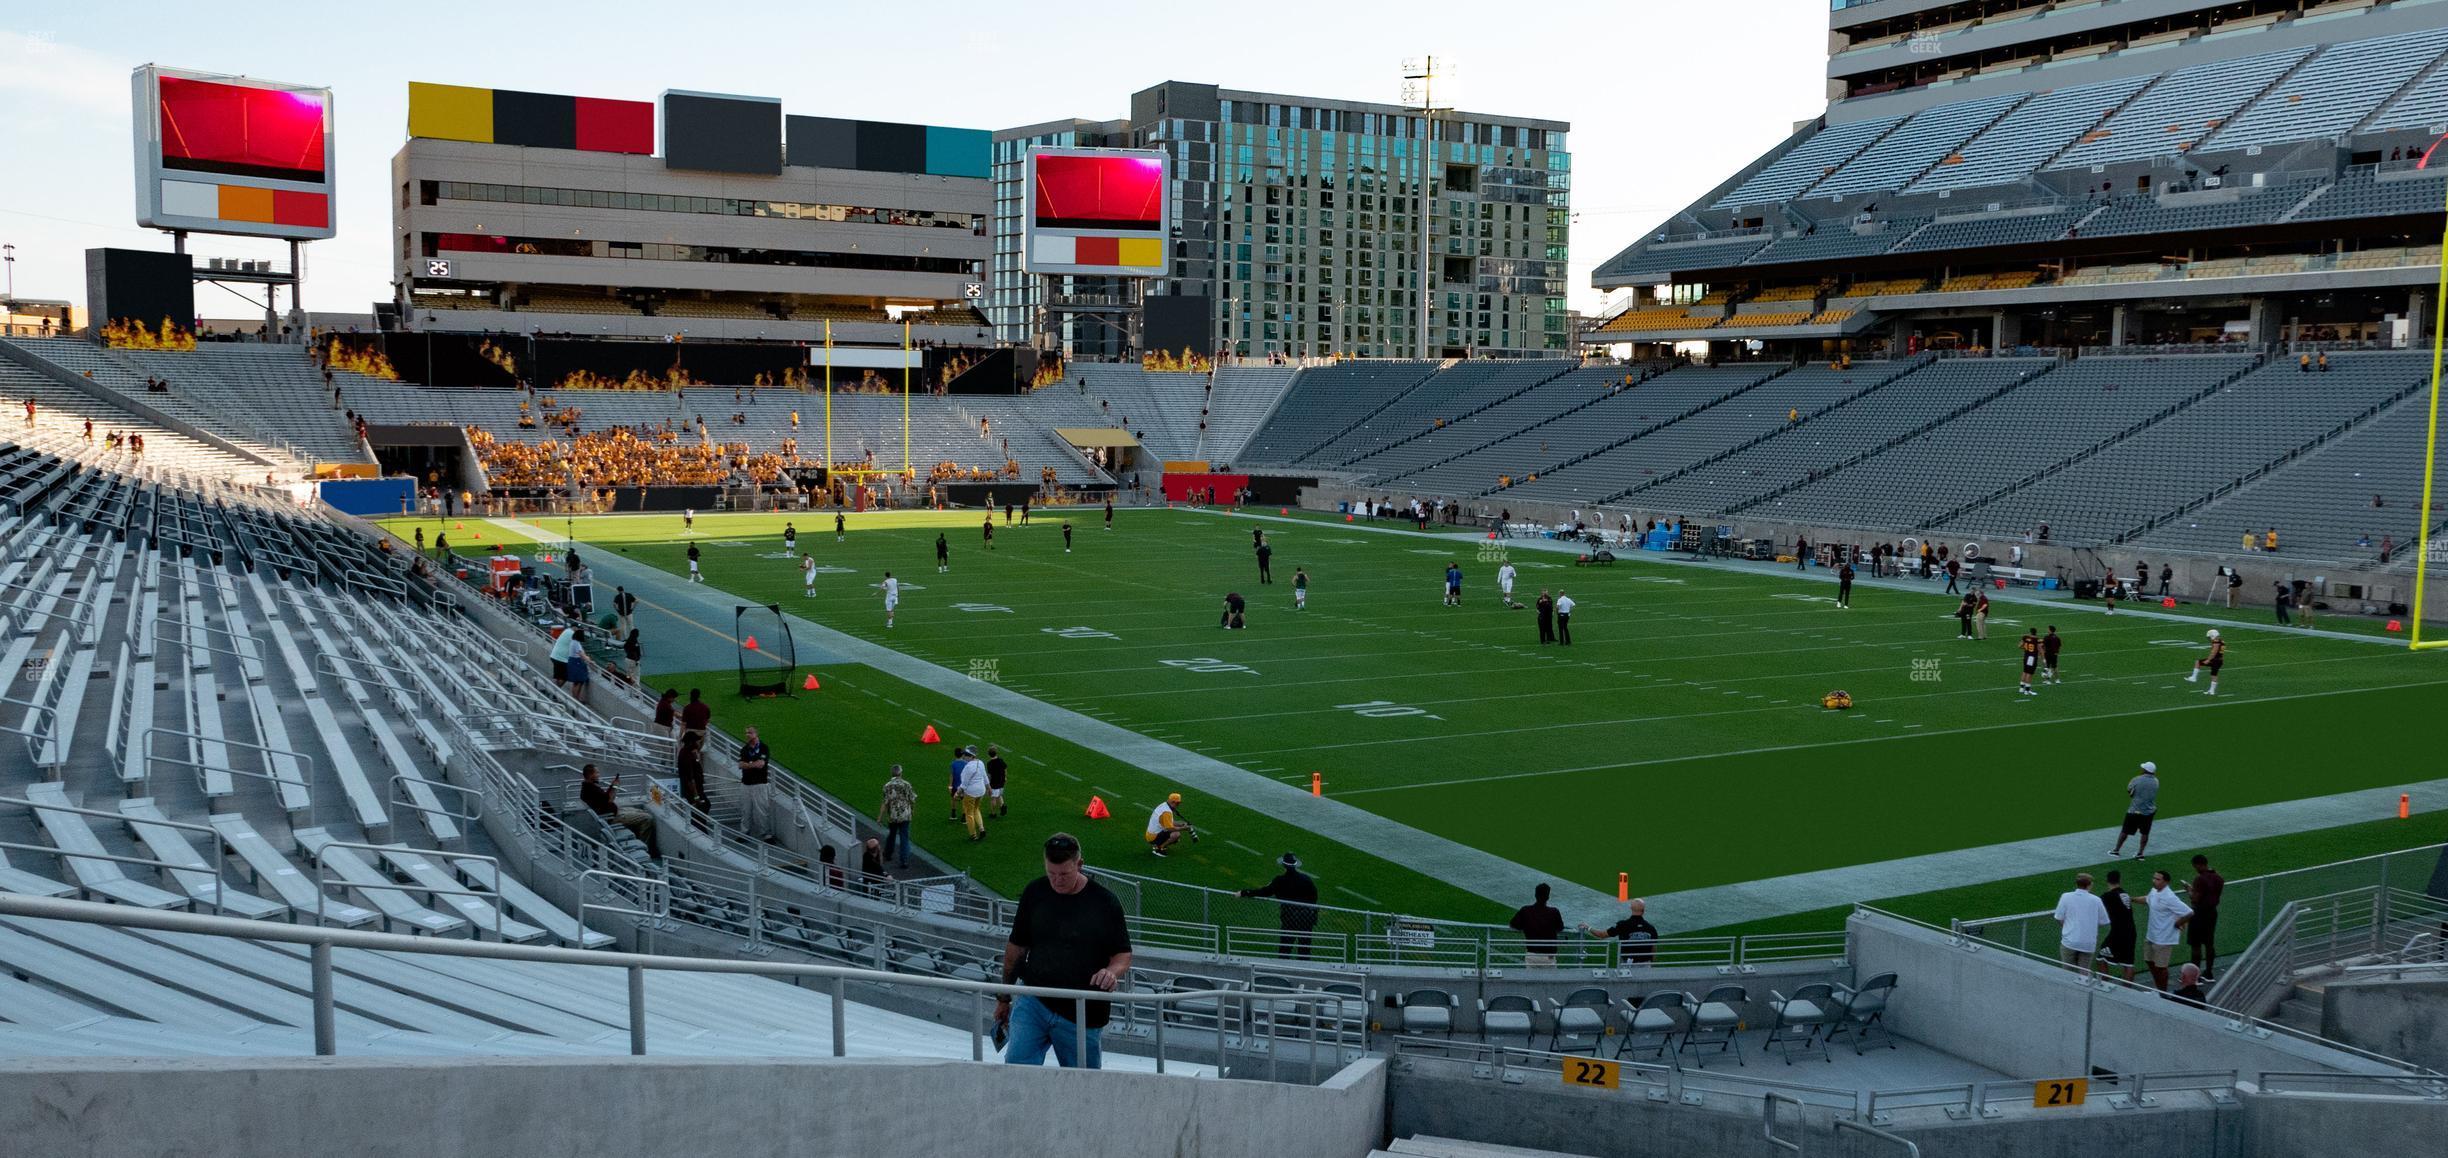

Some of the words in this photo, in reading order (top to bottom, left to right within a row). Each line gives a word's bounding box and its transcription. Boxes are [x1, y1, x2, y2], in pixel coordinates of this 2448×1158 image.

[429, 261, 448, 276] 25
[966, 284, 981, 297] 25
[1158, 657, 1249, 673] 20
[1332, 700, 1427, 718] 10
[1576, 1062, 1605, 1085] 22
[2048, 1082, 2074, 1104] 21
